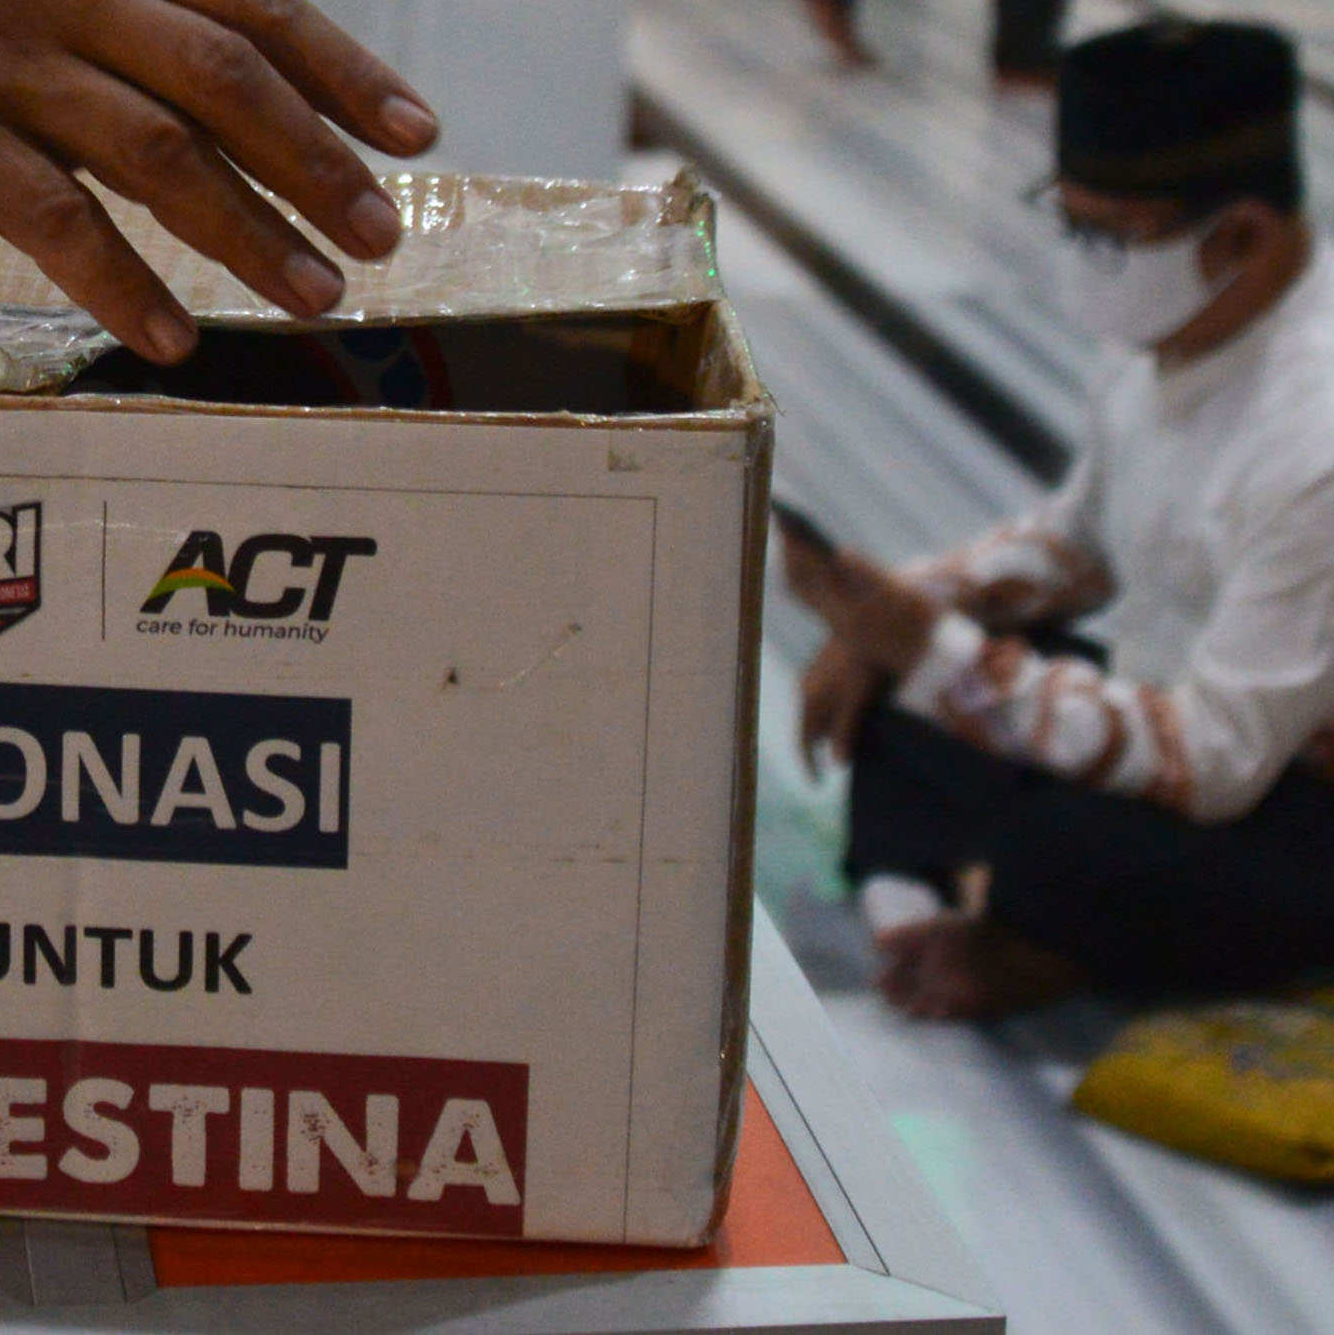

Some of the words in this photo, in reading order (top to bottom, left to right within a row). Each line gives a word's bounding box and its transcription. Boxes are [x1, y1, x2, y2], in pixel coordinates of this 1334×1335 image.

[140, 529, 378, 621] ACT
[136, 619, 183, 635] care
[188, 618, 218, 637] for
[223, 620, 330, 645] humanity
